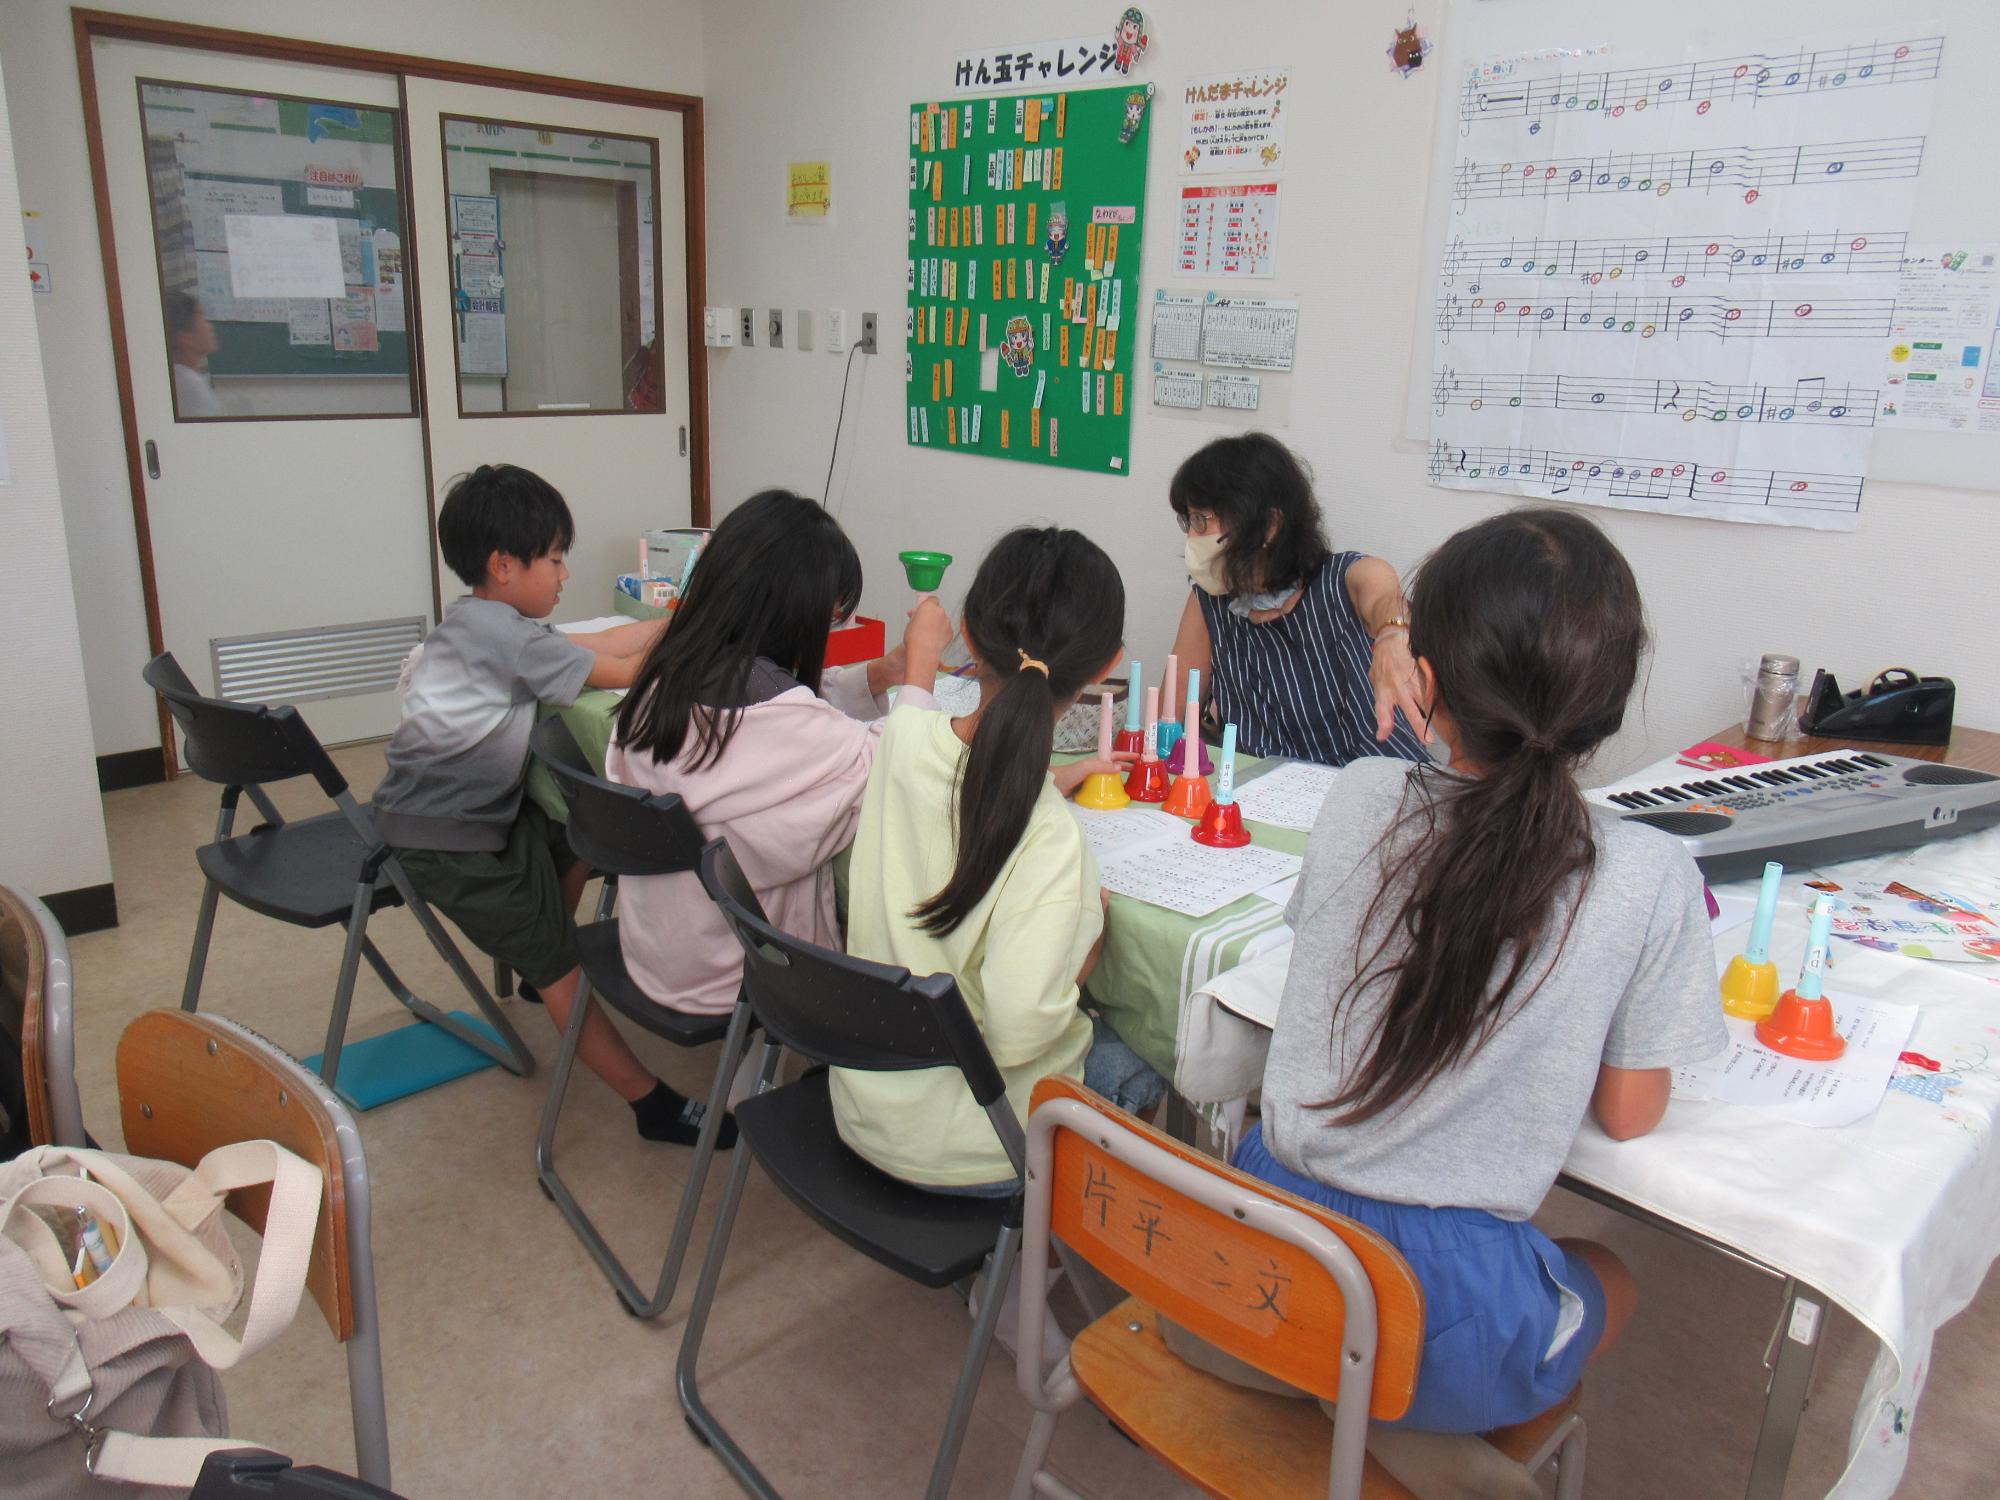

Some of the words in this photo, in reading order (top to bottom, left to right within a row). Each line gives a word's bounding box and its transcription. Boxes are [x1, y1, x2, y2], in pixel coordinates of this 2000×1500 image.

[956, 43, 1117, 87] けん玉チャレンジ
[1185, 76, 1287, 104] けんだまチャレンジ
